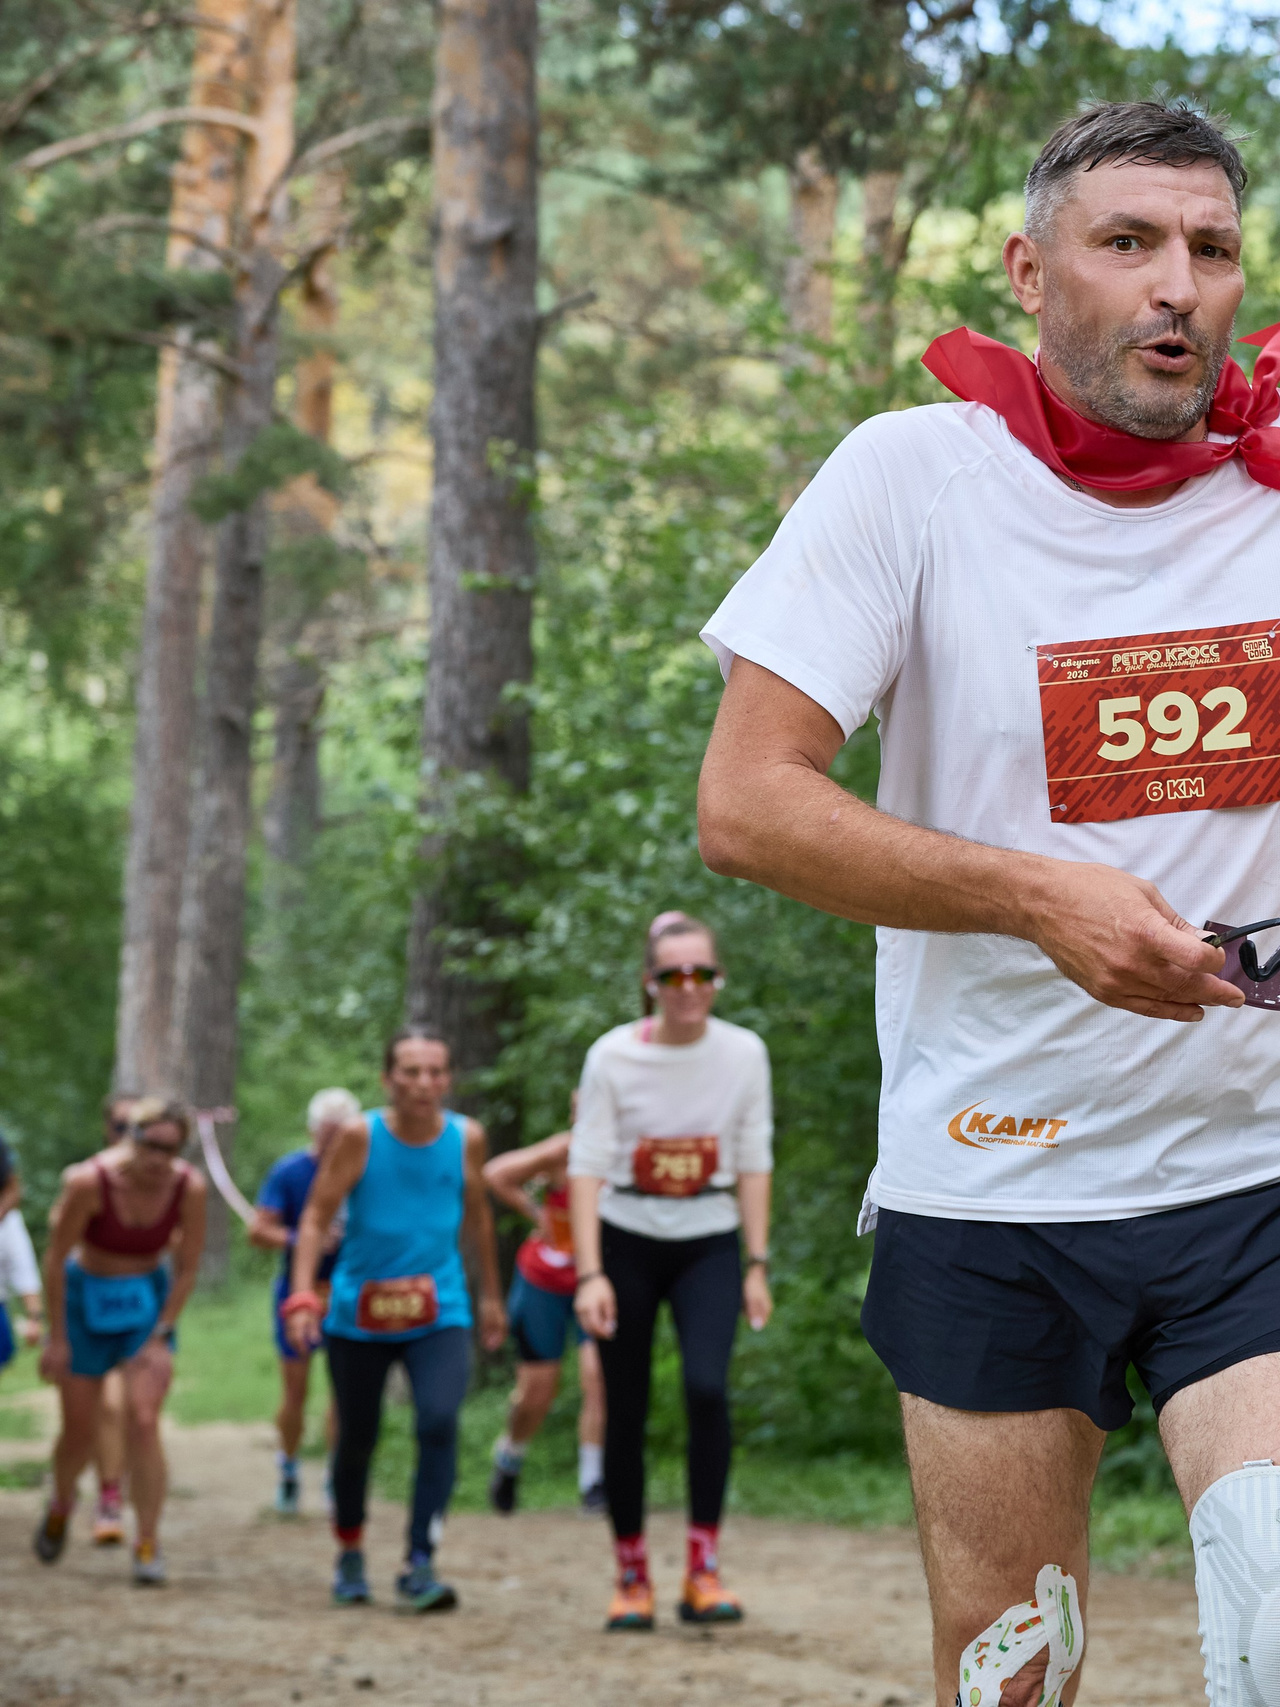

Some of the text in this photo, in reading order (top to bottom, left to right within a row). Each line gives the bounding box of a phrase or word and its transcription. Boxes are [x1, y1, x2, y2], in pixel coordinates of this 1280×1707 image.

[1243, 639, 1268, 651] СПОРТ
[1112, 643, 1220, 667] РЕТРО КРОСС
[1249, 647, 1272, 659] СОЮЗ
[1053, 658, 1101, 670] 9 августа
[1124, 664, 1143, 674] дню
[1146, 658, 1221, 671] физкультурника
[1067, 669, 1089, 680] 2026
[1097, 686, 1252, 762] 592
[1146, 777, 1205, 802] 6 КМ
[965, 1111, 1068, 1140] КАНТ
[977, 1136, 1060, 1149] СПОРТИВНЫЙ МАГАЗИН
